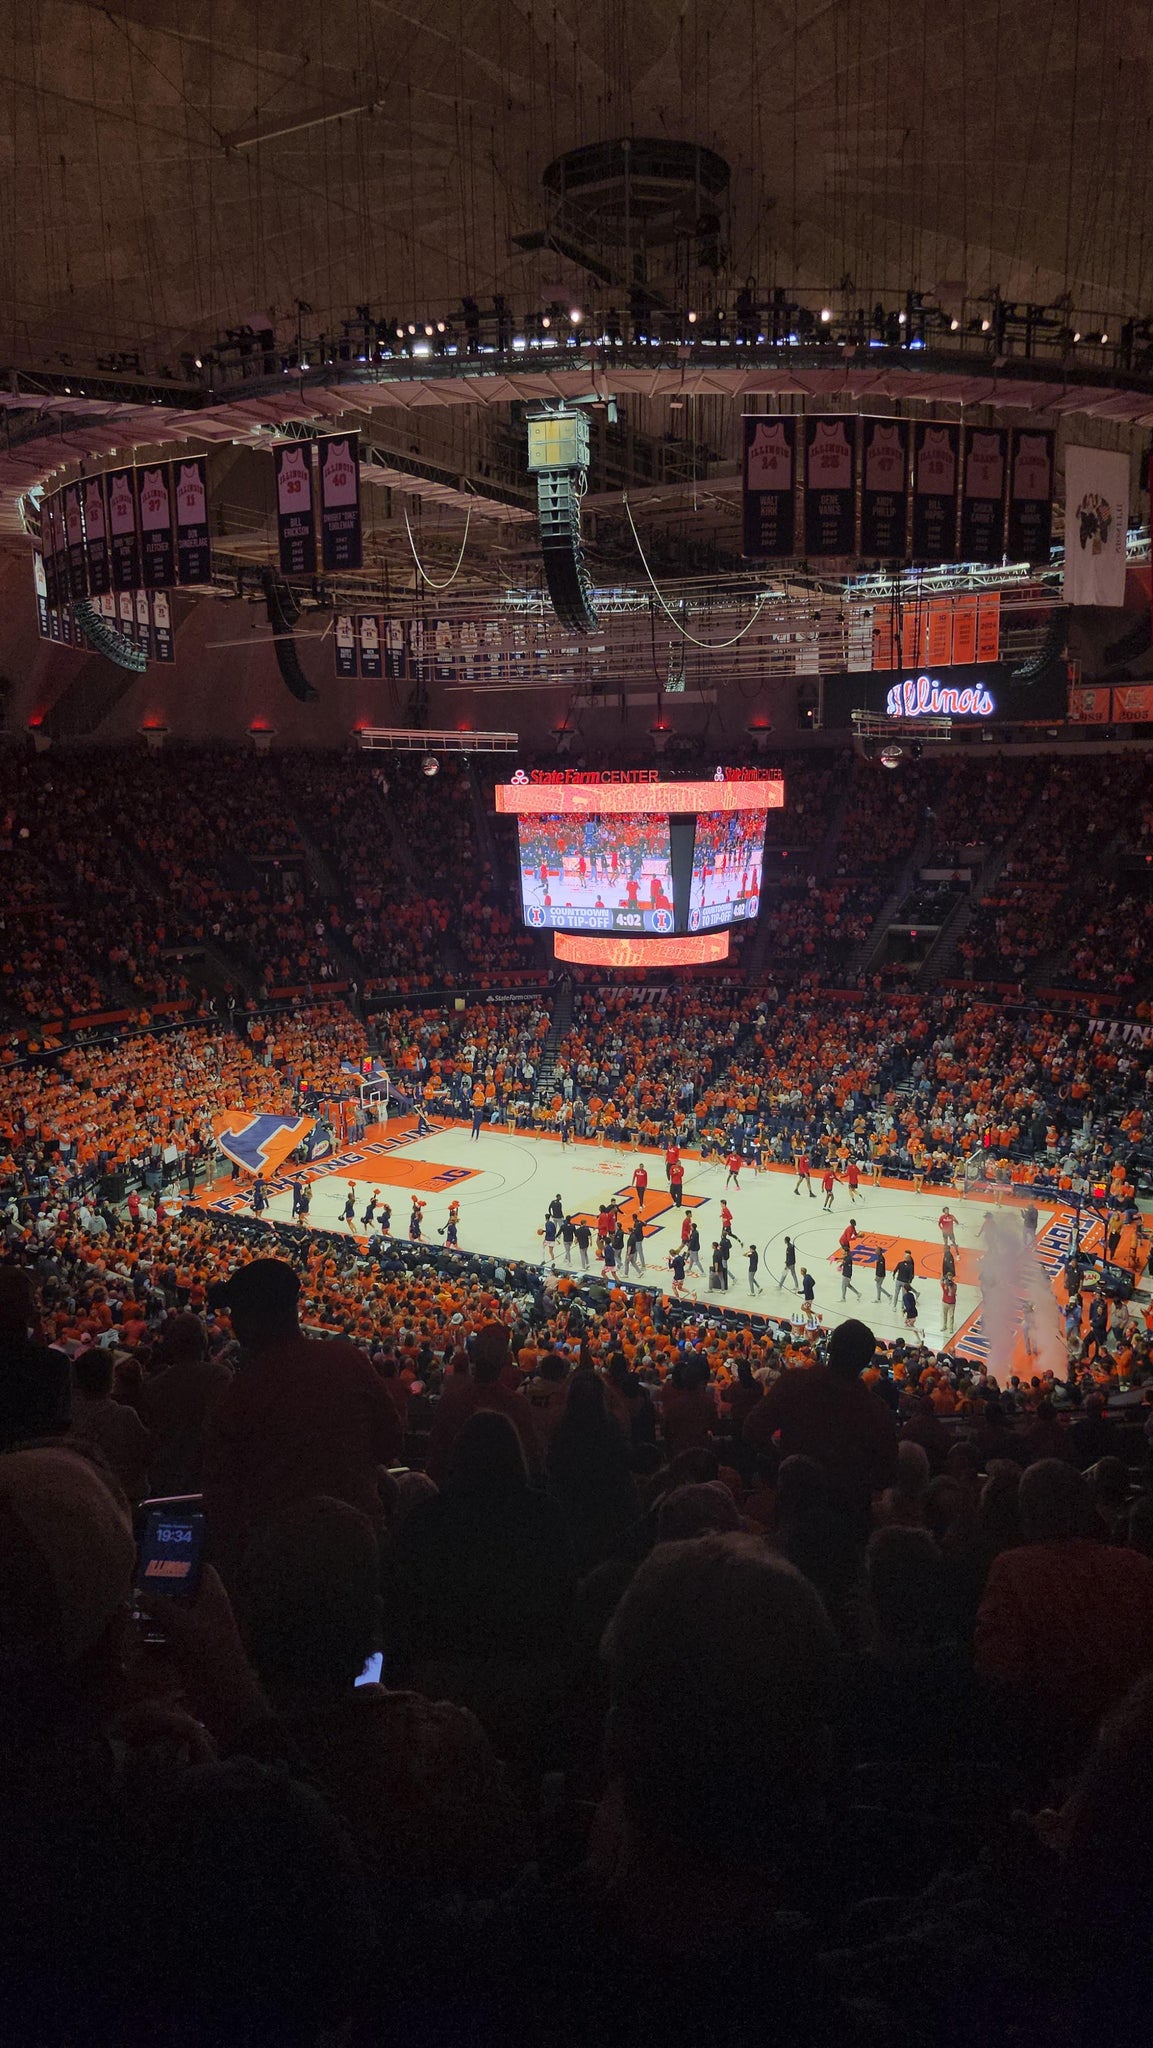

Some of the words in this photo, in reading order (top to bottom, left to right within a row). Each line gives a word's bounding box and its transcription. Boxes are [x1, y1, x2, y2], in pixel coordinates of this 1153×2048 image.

[332, 473, 347, 486] 40
[287, 481, 301, 494] 33
[148, 499, 161, 512] 37
[887, 676, 993, 717] Illinois
[1119, 710, 1150, 720] 2005
[601, 769, 659, 783] CENTER
[550, 907, 609, 917] COUNTDOWN
[550, 916, 566, 926] TO
[568, 917, 609, 928] TIP-OFF
[616, 913, 641, 927] 4:02
[156, 1530, 192, 1543] 19:34
